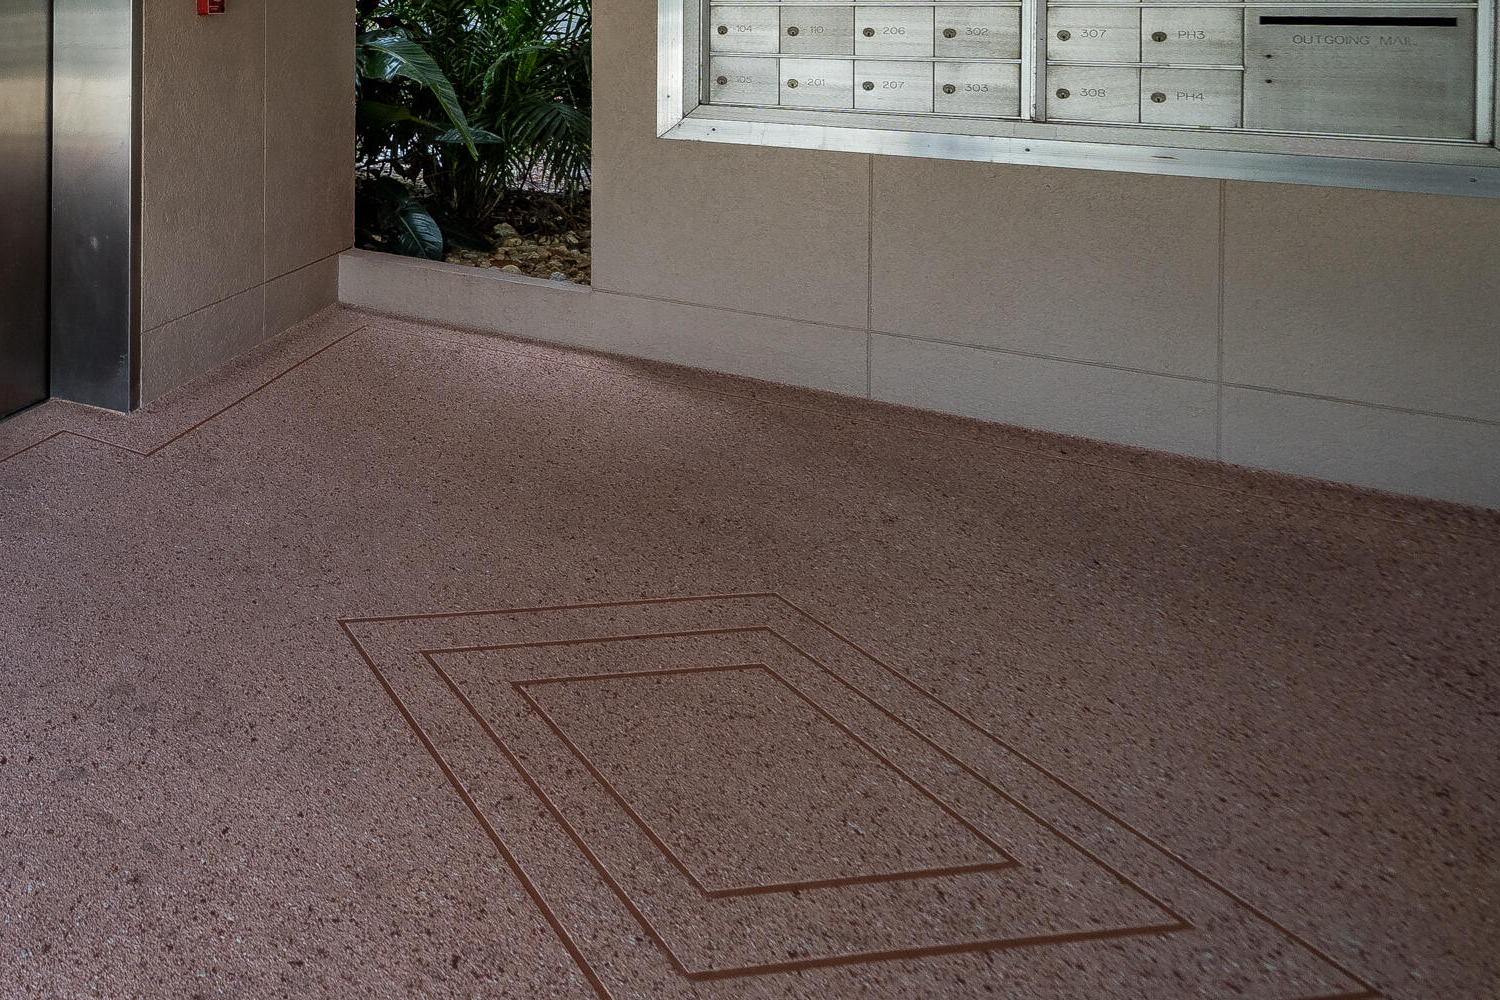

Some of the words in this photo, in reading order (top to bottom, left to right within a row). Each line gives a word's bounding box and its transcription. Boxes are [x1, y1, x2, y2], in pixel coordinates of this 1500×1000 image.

[810, 26, 824, 34] 110
[883, 27, 905, 35] 206
[965, 27, 988, 36] 302
[1081, 30, 1107, 38] 307
[1178, 31, 1205, 40] PH3
[1292, 34, 1370, 45] OUTGOING
[1380, 36, 1418, 46] MAIL
[807, 78, 825, 86] 201
[882, 81, 905, 89] 207
[965, 84, 989, 92] 303
[1080, 89, 1106, 97] 308
[1177, 92, 1204, 101] PH4
